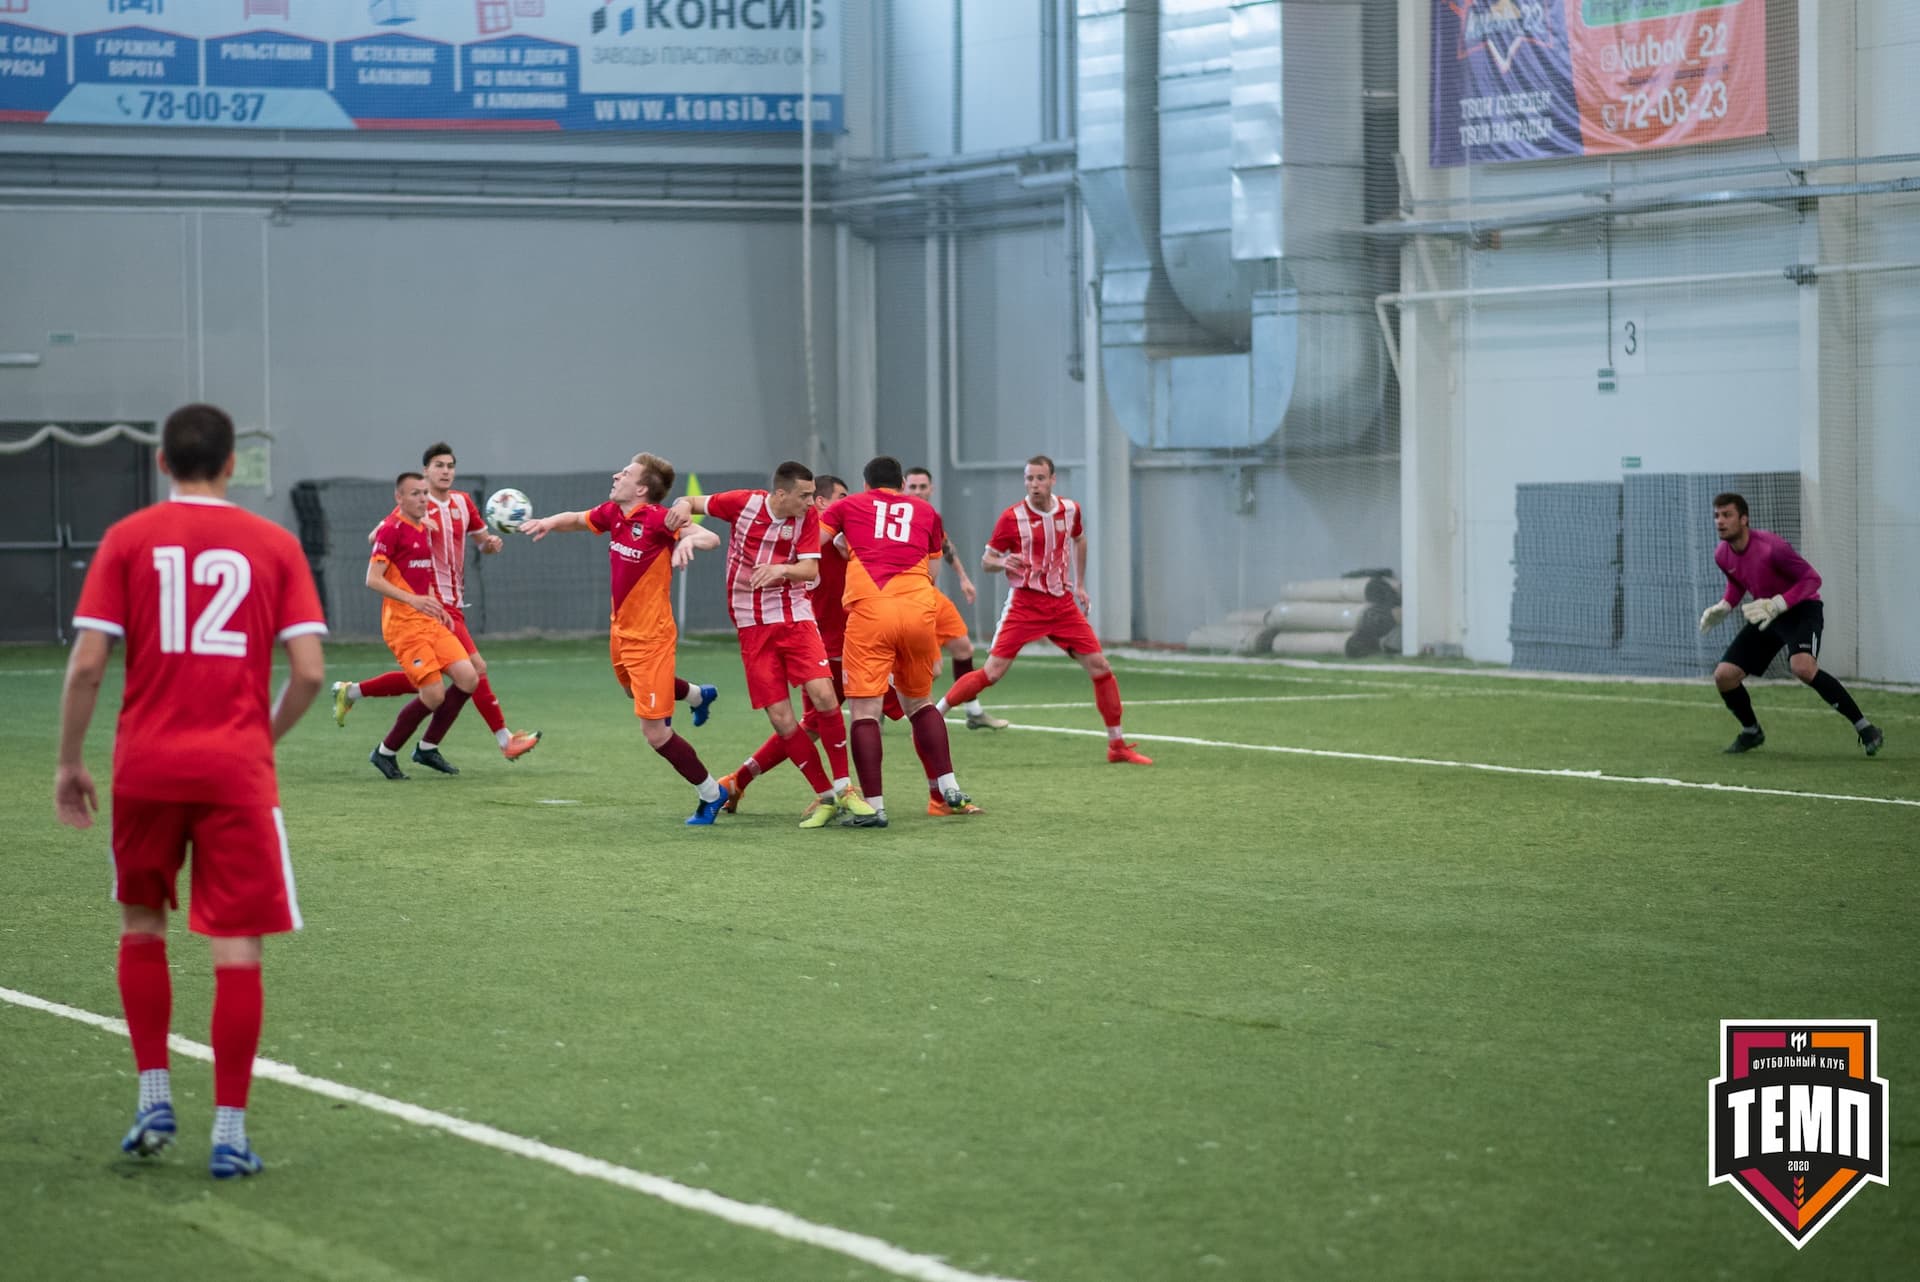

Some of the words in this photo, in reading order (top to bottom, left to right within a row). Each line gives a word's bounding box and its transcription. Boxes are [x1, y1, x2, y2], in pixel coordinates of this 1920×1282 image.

[139, 90, 266, 121] 73-00-37
[1620, 80, 1729, 130] 72-03-23
[1625, 321, 1637, 355] 3
[873, 500, 914, 543] 13
[153, 546, 251, 657] 12
